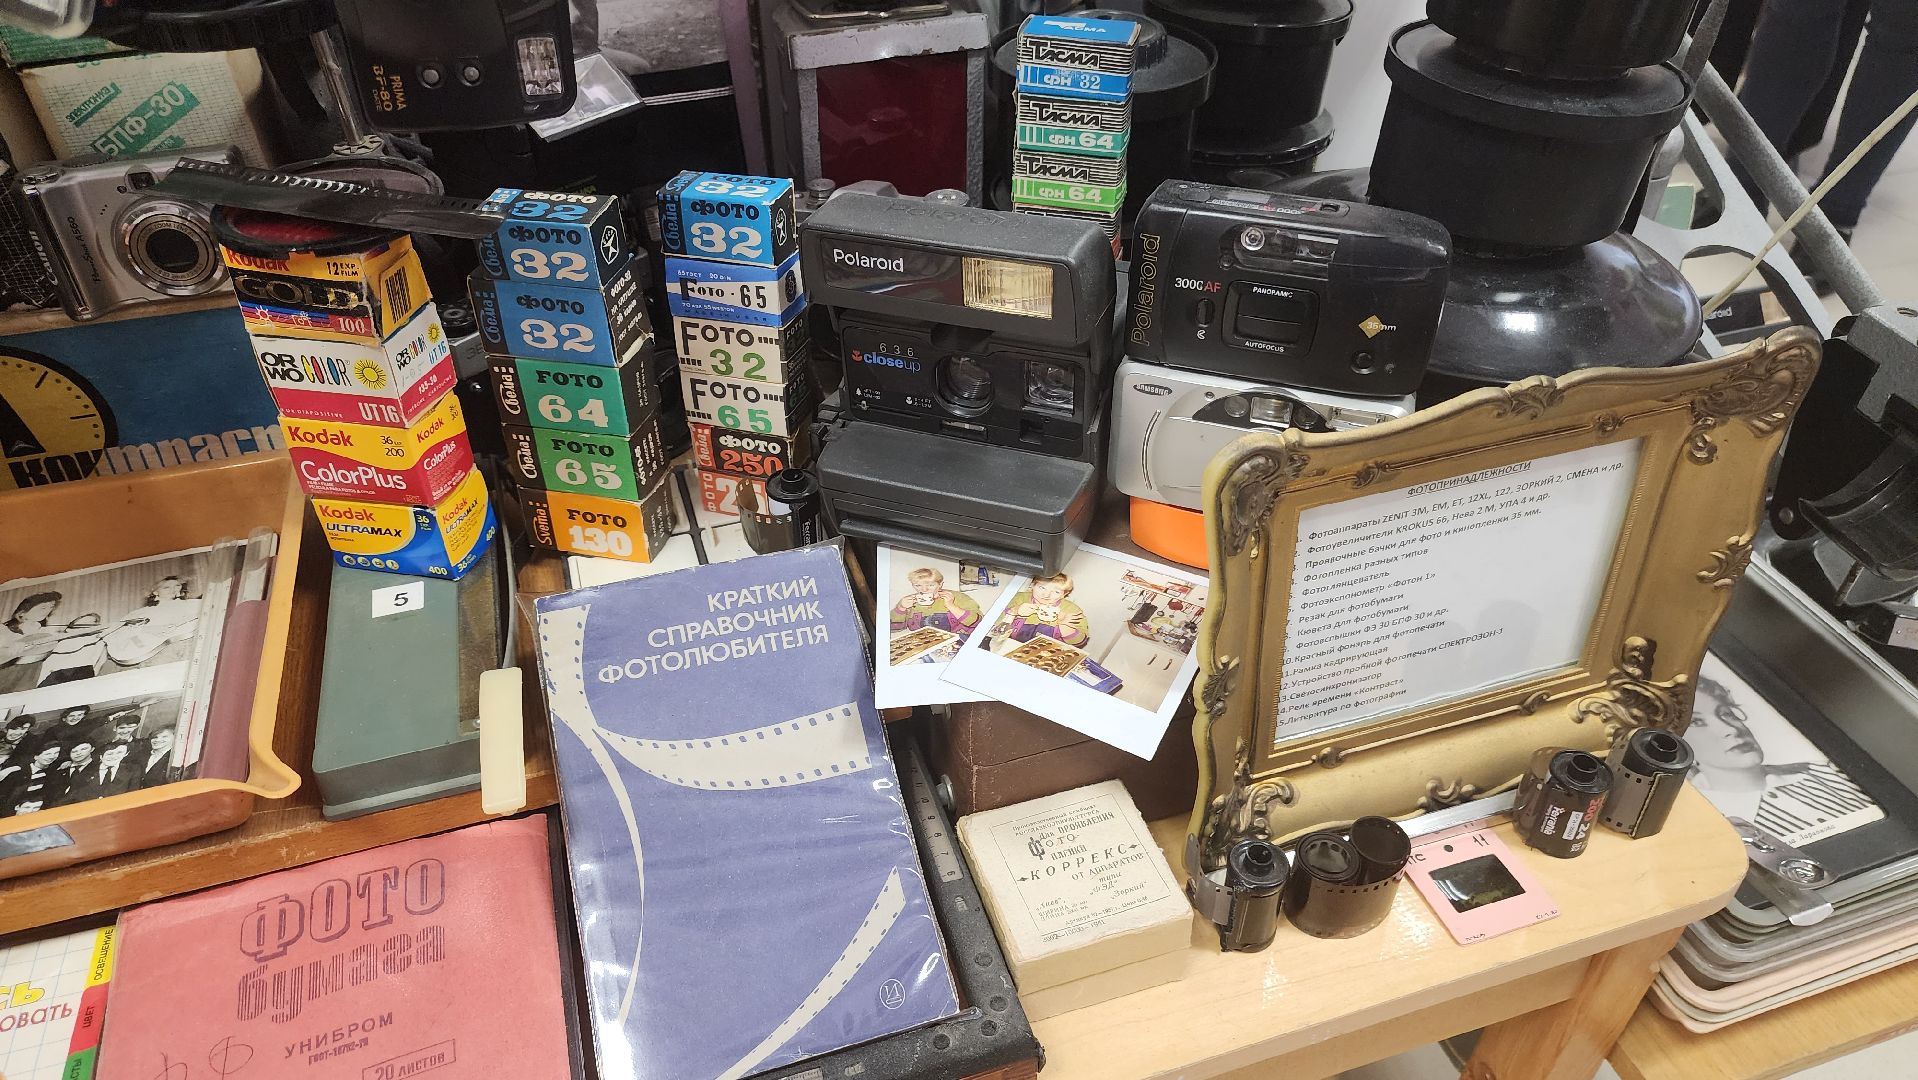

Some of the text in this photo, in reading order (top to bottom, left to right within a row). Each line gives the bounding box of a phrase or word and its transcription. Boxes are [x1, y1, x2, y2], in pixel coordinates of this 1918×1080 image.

[371, 65, 392, 112] BF-80
[389, 76, 407, 111] PRIMA
[1079, 74, 1101, 89] 32
[1078, 133, 1115, 150] 64
[695, 180, 769, 198] 32
[1068, 187, 1102, 202] 64
[511, 200, 588, 221] 32
[691, 200, 760, 220] ФОТО
[508, 225, 582, 245] ФОТО
[691, 222, 763, 259] 32
[326, 260, 340, 277] 12
[510, 248, 590, 282] 32
[833, 247, 904, 273] Polaroid
[740, 284, 767, 309] 65
[1130, 233, 1161, 346] Polaroid
[516, 294, 585, 315] ФОТО
[335, 315, 366, 335] 100
[520, 318, 596, 353] 32
[680, 320, 755, 356] FOTO
[1366, 321, 1397, 332] 35mm
[1244, 340, 1285, 353] AUTOFOCUS
[709, 348, 767, 381] 32
[498, 372, 522, 415] Свема
[535, 370, 604, 389] FOTO
[690, 377, 761, 410] FOTO
[1135, 384, 1170, 396] SAMSUNG
[538, 394, 609, 428] 64
[717, 404, 773, 434] 65
[287, 425, 393, 448] Kodak 36
[416, 417, 446, 444] Kodak
[718, 434, 782, 455] ФОТО
[385, 447, 406, 458] 200
[423, 439, 457, 472] ColorPlus
[516, 440, 538, 479] Свема
[551, 438, 615, 458] FOTO
[300, 460, 407, 491] ColorPlus
[555, 458, 622, 491] 65
[719, 449, 784, 478] 250
[1407, 461, 1532, 496] ФОТОПРИНАДЛЕЖНОСТИ
[319, 504, 376, 523] Kodak
[441, 497, 469, 525] Kodak
[1308, 517, 1381, 541] Фотоаппараты
[1382, 509, 1410, 524] ZENIT
[1452, 498, 1466, 508] ET,
[1515, 475, 1554, 494] ЗОРКИЙ
[1566, 465, 1600, 481] СМЕНА
[326, 522, 403, 539] ULTRAMAX
[417, 513, 430, 525] 36
[533, 506, 553, 546] Svema
[566, 508, 628, 529] FOTO
[1307, 529, 1394, 555] Фотоувеличители
[1395, 518, 1434, 535] KROKUS
[1436, 515, 1450, 525] 66,
[1452, 511, 1475, 522] Нева
[1476, 506, 1484, 516] 2
[1499, 498, 1519, 510] УПА
[1528, 495, 1536, 503] и
[1536, 492, 1552, 502] др.
[1368, 542, 1397, 555] бачки
[1398, 538, 1417, 550] для
[1418, 531, 1443, 544] фото
[1444, 529, 1452, 537] и
[1452, 516, 1509, 536] кинопленки
[1511, 512, 1523, 521] 35
[1524, 508, 1543, 518] мм.
[484, 525, 496, 542] 400
[568, 525, 633, 557] 130
[428, 564, 449, 577] 400
[457, 560, 468, 574] 36
[1303, 548, 1430, 583] Фотопленка разных типов
[392, 591, 410, 608] 5
[707, 575, 819, 612] КРАТКИЙ
[1297, 604, 1410, 637] Кювета для фотобумаги
[1298, 593, 1405, 624] Резак для фотобумаги
[1363, 624, 1378, 634] ФЭ
[1391, 615, 1413, 627] БПФ
[1414, 612, 1426, 622] 30
[1434, 608, 1450, 619] др.
[647, 600, 824, 649] СПРАВОЧНИК
[1372, 633, 1391, 645] для
[1392, 620, 1446, 640] фотопечати
[598, 624, 830, 684] ФОТОЛЮБИТЕЛЯ
[1343, 658, 1383, 675] пробной
[1384, 646, 1438, 666] фотопечати
[1339, 688, 1408, 712] по фотографии
[1057, 811, 1115, 835] ПРОЯВЛЕНИЯ
[1545, 805, 1566, 837] Ferrania
[1030, 842, 1128, 882] КОРРЕКС
[1050, 844, 1088, 862] ПЛЕНКИ
[1071, 851, 1145, 882] ОТ АППАРАТОВ
[239, 858, 446, 963] ФОТО
[93, 928, 114, 981] ОСВЕЩЕНИЕ
[237, 924, 447, 1024] бумага
[82, 1005, 95, 1029] ЦВЕТ
[284, 1012, 394, 1060] УНИБРОМ
[375, 1051, 446, 1080] 20 ЛИСТОВ
